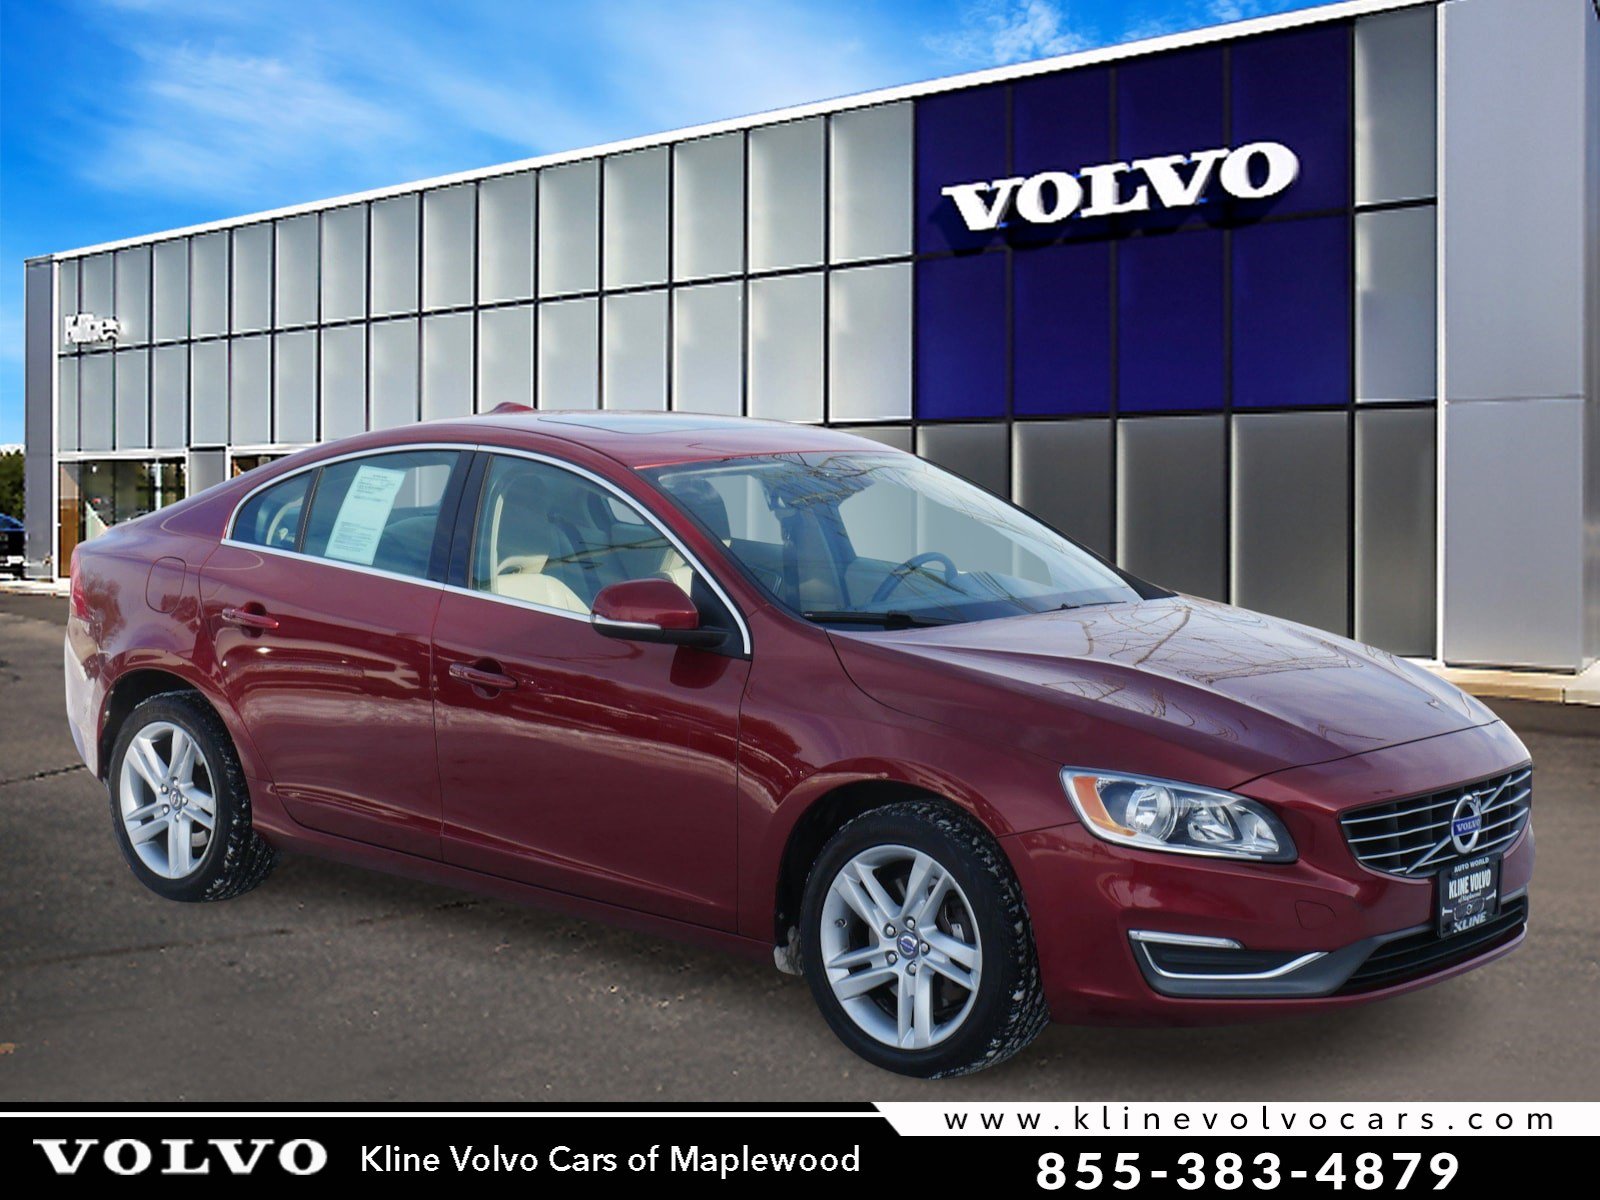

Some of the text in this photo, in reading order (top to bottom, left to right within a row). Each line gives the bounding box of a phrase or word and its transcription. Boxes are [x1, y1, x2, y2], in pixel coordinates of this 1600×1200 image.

[942, 142, 1298, 230] VOLVO
[1456, 818, 1480, 832] VOLVO
[1454, 857, 1490, 873] AUTO WORLD
[1449, 875, 1469, 899] KLINE
[1470, 869, 1491, 892] VOLVO
